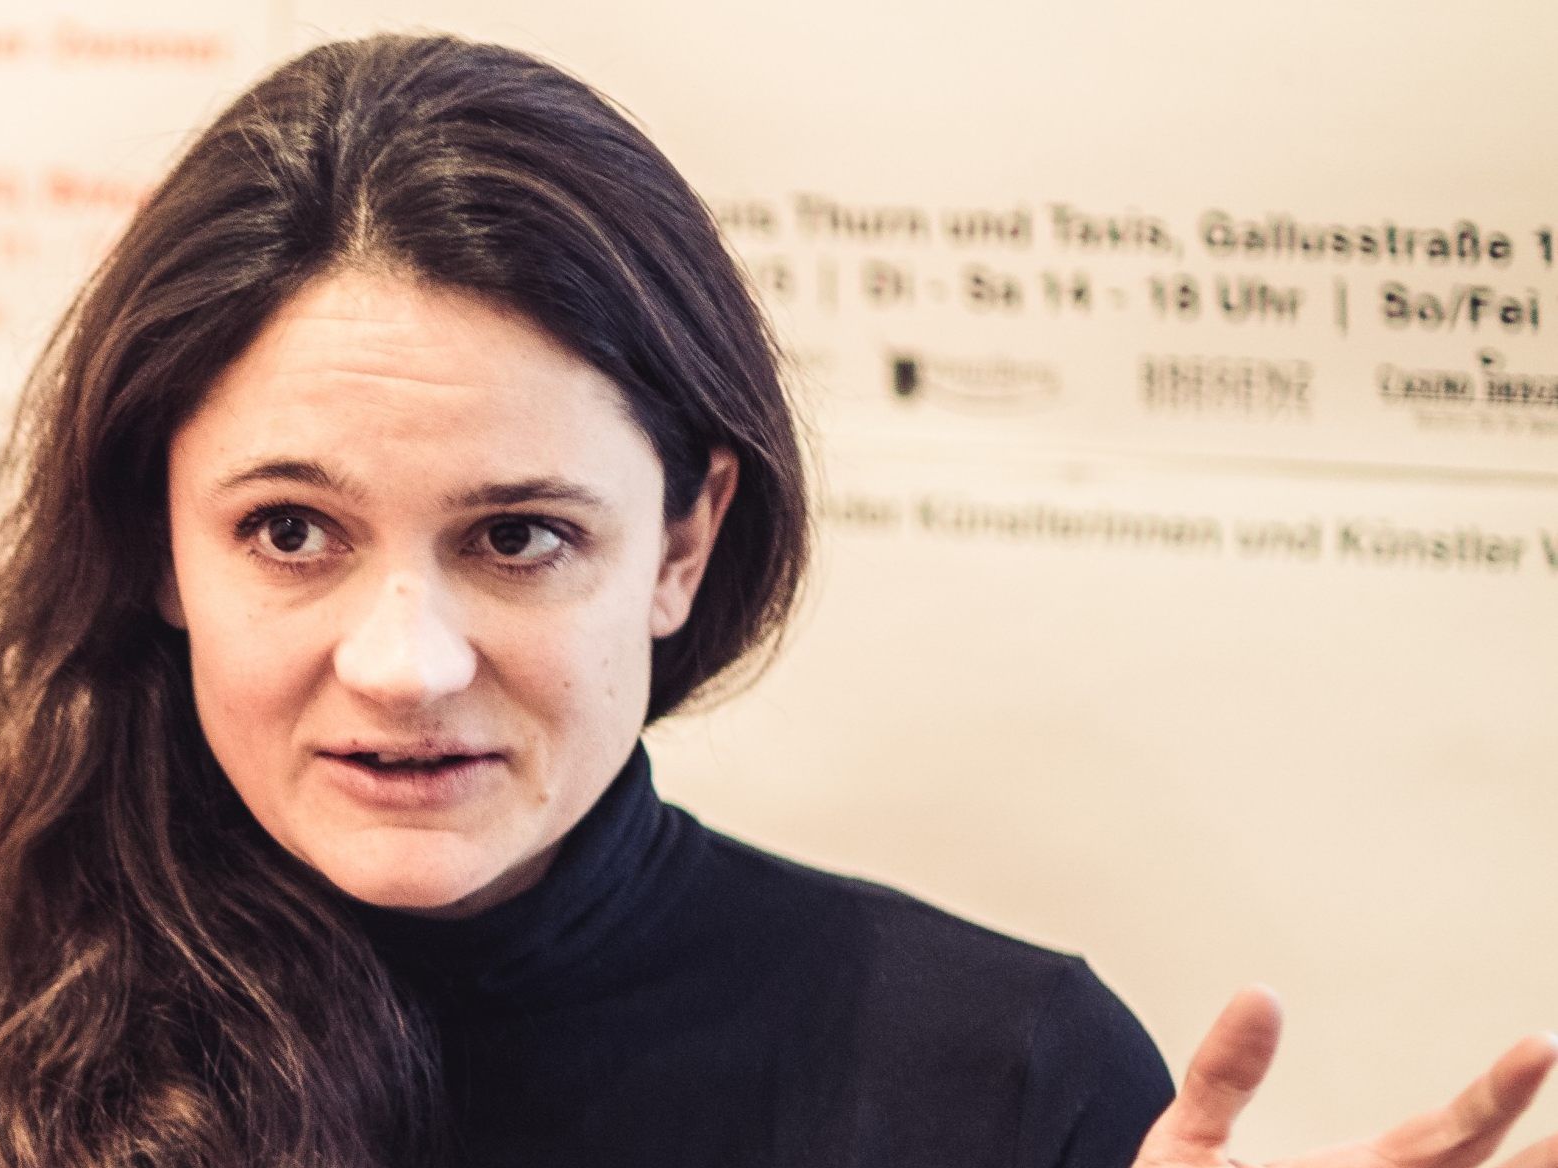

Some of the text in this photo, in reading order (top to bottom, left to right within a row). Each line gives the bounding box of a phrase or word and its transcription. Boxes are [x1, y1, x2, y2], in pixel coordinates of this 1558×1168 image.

[791, 191, 929, 245] Thurn
[939, 203, 1035, 249] und
[1197, 208, 1513, 265] Gallusstraße
[960, 263, 1022, 313] Sa
[1214, 276, 1302, 323] Uhr
[1233, 513, 1323, 559] und
[1334, 514, 1526, 575] Künstler
